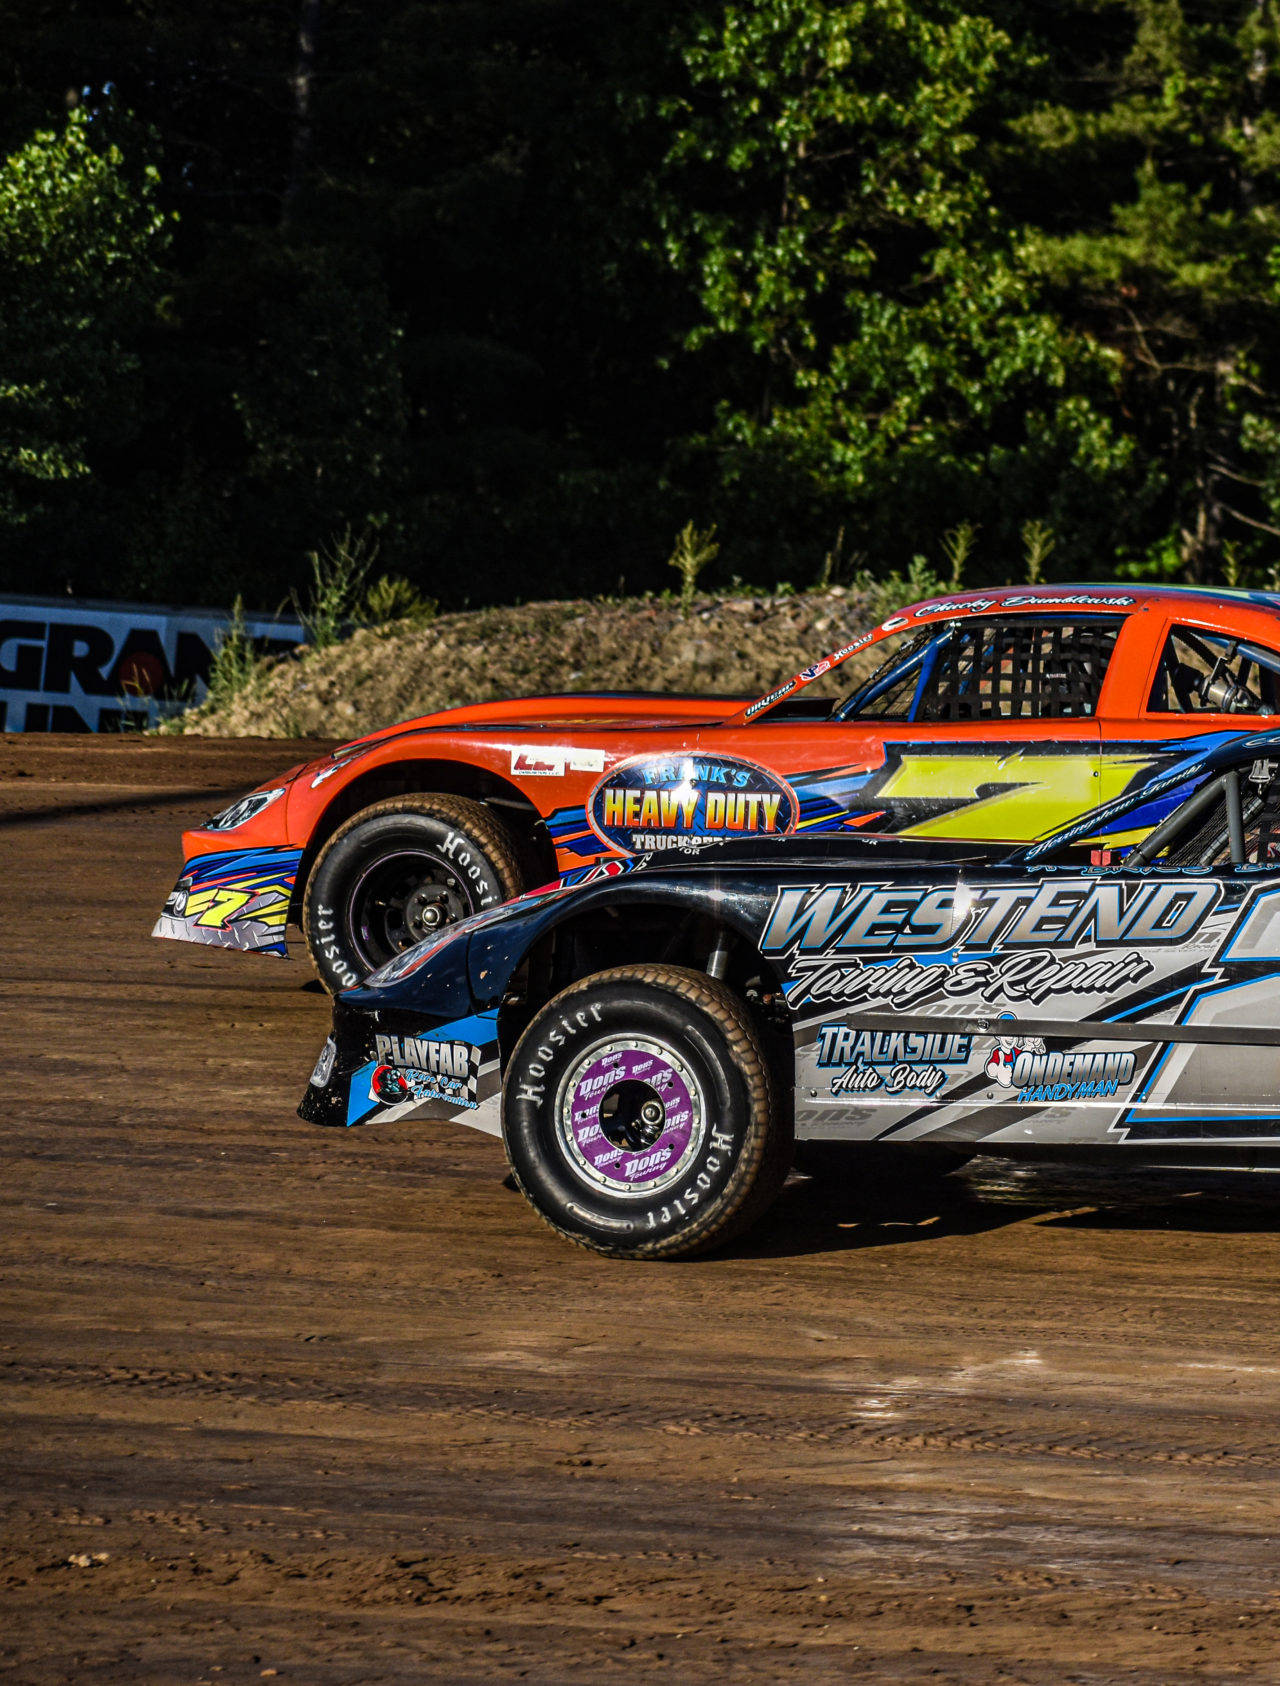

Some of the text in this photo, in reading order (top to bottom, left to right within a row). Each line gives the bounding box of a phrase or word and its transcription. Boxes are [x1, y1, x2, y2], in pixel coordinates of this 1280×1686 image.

[834, 632, 874, 662] Hoosier
[603, 787, 781, 832] HEAVY DUTY
[436, 831, 498, 906] Hoosi
[193, 886, 261, 932] 7
[760, 880, 1221, 953] WESTEND
[315, 903, 357, 987] oosier
[788, 951, 1156, 1009] Towing & Repair
[375, 1034, 470, 1078] PLAYFAB
[516, 1002, 603, 1108] Hoosier
[405, 1068, 463, 1090] Race Car
[410, 1083, 481, 1110] Fabrication
[831, 1063, 945, 1095] Auto Body
[1017, 1079, 1119, 1104] HANDYMAN
[644, 1123, 735, 1231] Hoosier
